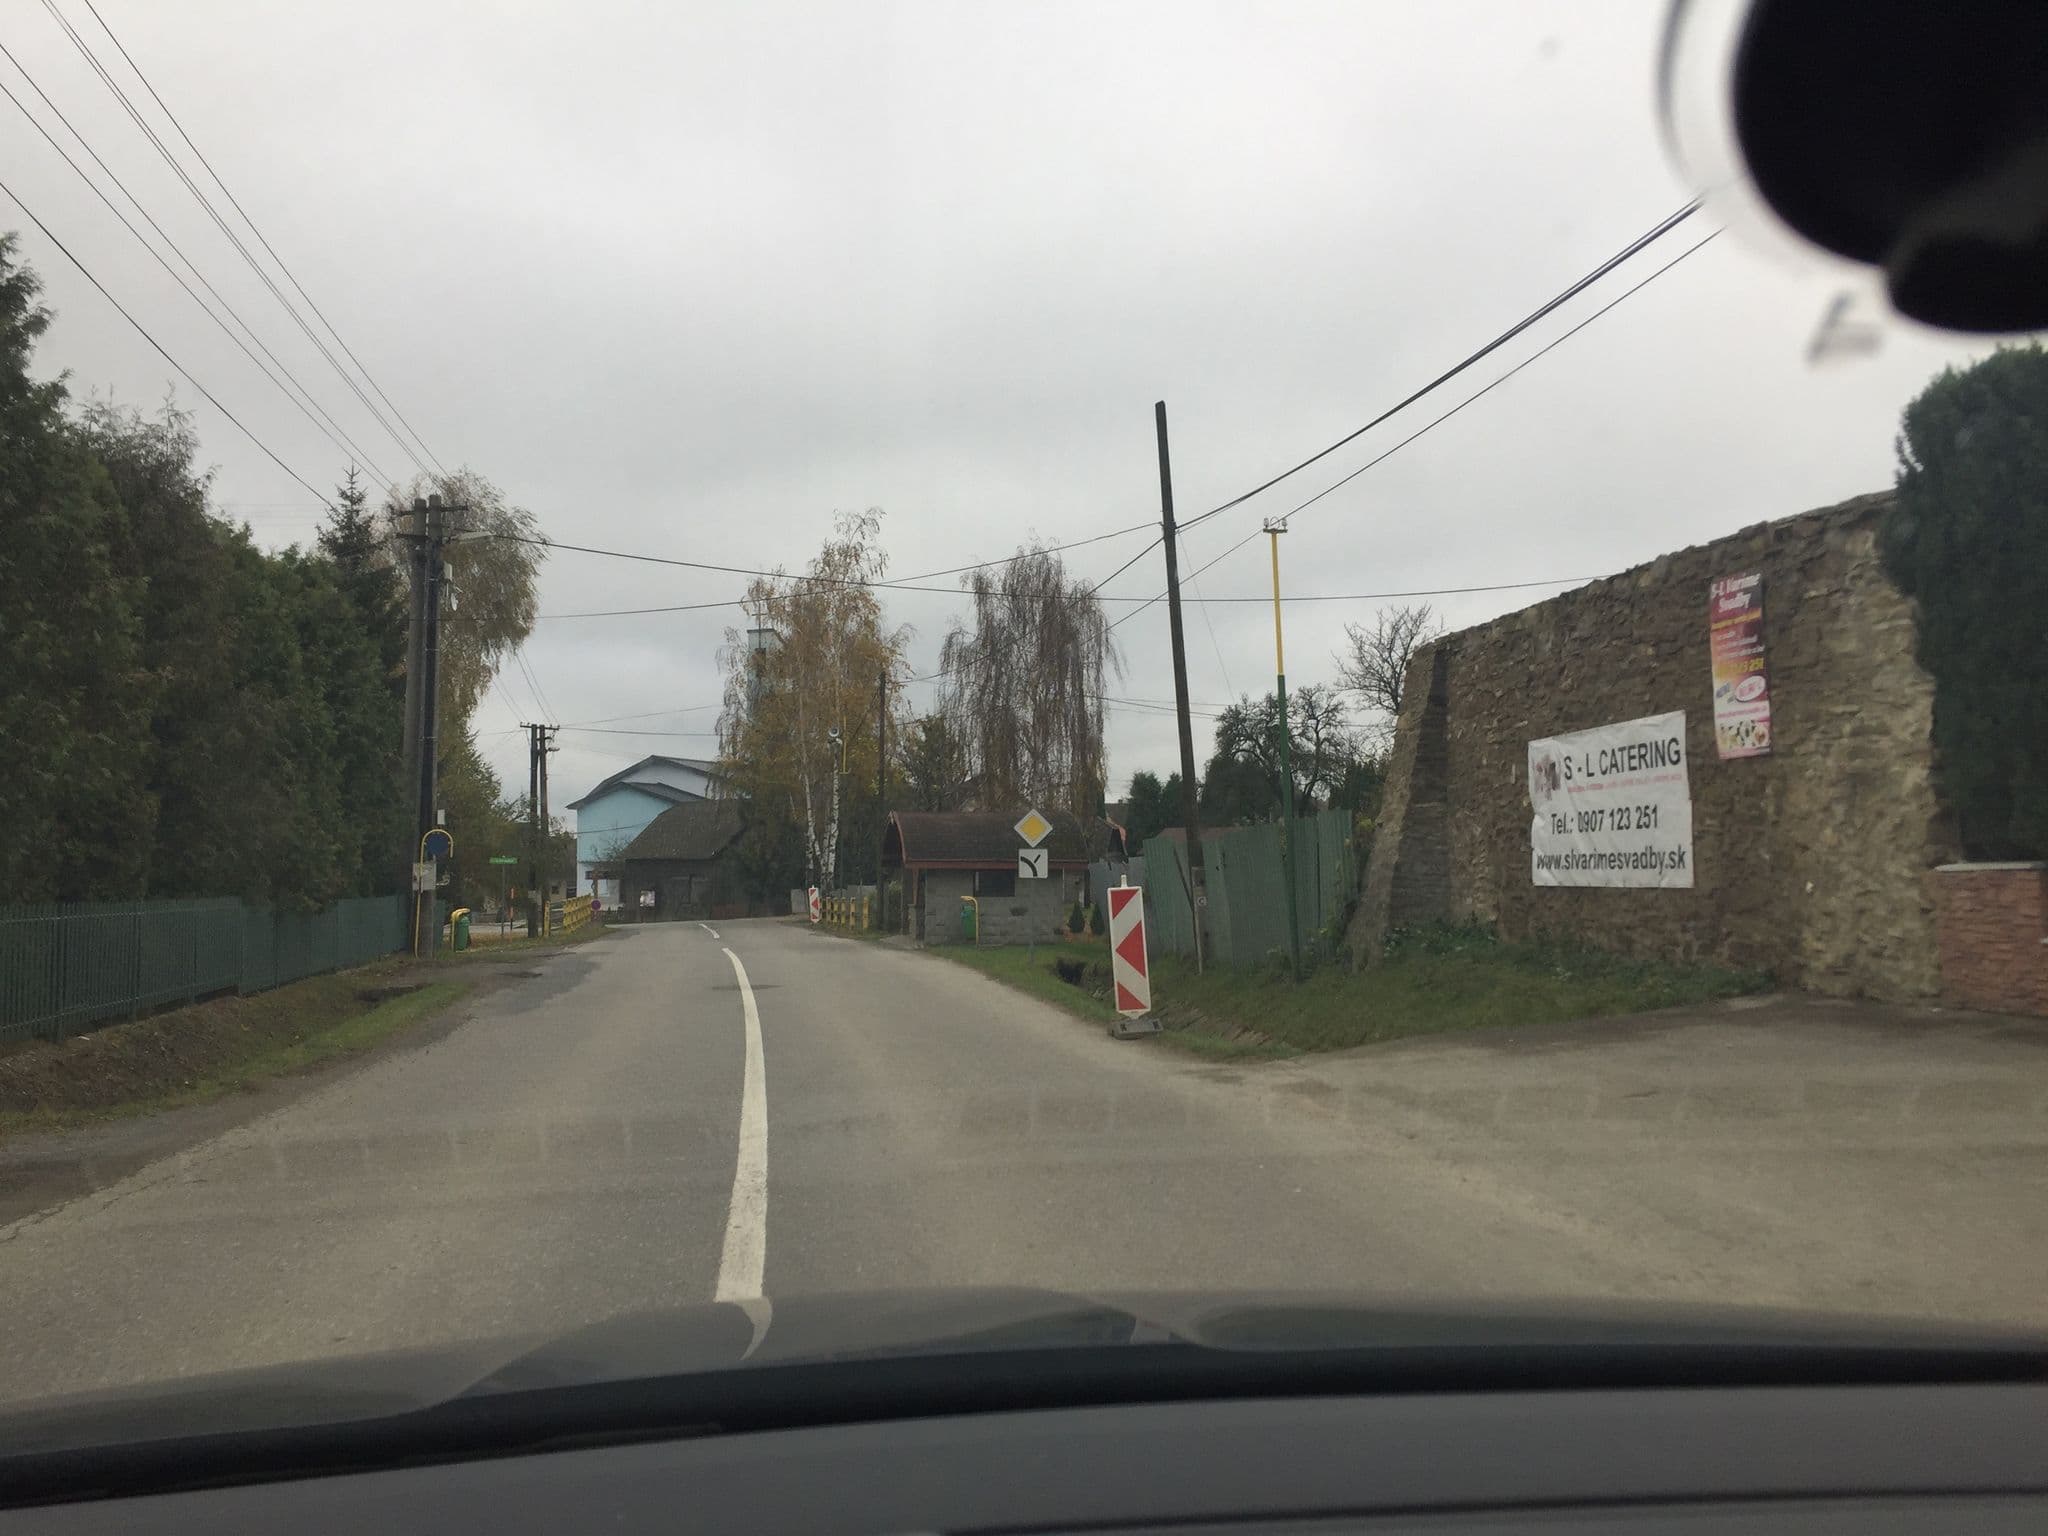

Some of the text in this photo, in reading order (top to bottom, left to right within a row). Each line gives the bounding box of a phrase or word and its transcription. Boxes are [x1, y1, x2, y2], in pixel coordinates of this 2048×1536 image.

[1599, 737, 1681, 776] CATERING
[1551, 804, 1658, 835] Tel.: 0907 123 251
